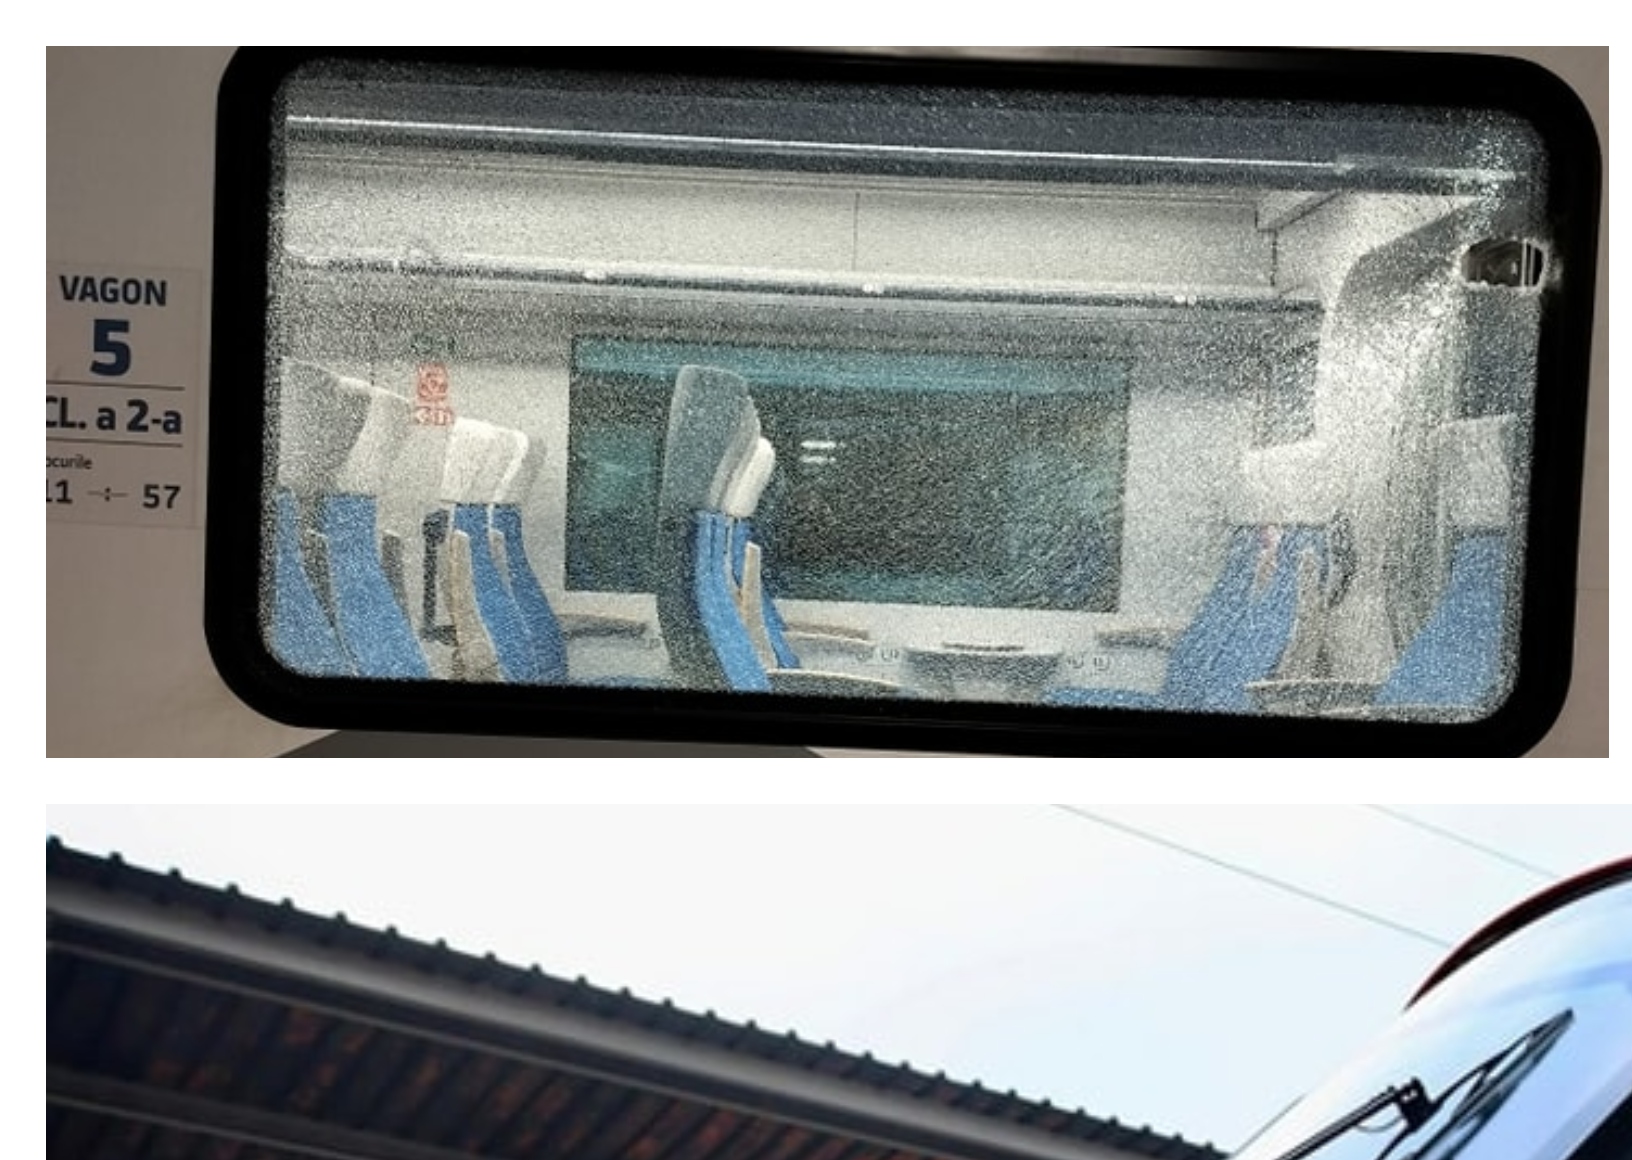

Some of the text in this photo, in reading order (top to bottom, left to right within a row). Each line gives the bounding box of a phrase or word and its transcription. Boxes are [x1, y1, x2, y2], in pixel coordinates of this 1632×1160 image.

[59, 275, 167, 306] VAGON
[90, 318, 131, 376] 5
[96, 406, 116, 431] a
[126, 399, 182, 434] 2-a
[142, 484, 181, 509] 57
